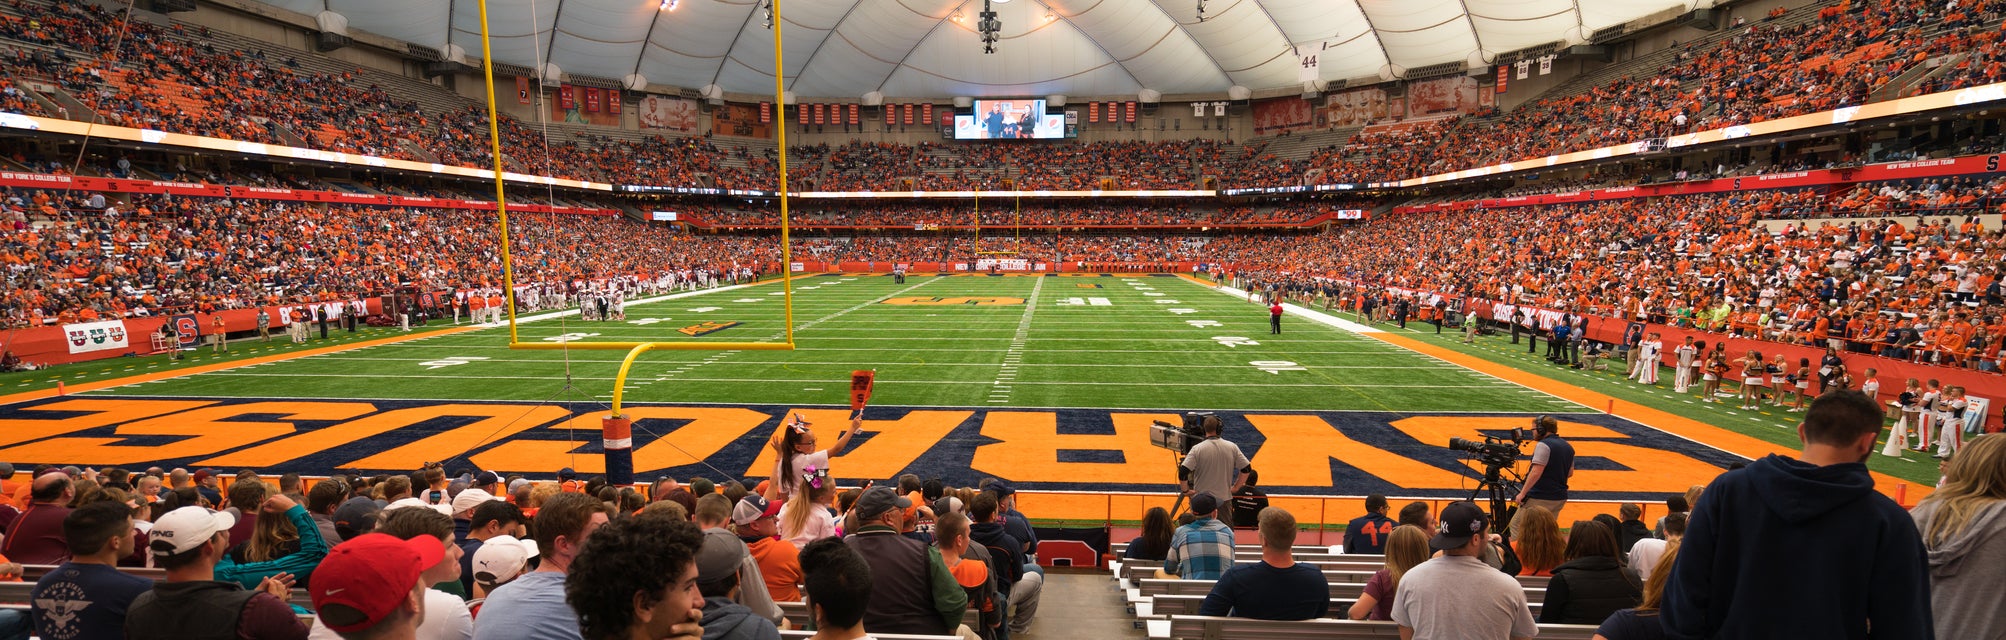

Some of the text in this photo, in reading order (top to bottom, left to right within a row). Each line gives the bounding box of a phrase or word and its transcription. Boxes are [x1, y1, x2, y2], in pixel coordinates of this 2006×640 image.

[1302, 55, 1317, 68] 44
[1986, 156, 2000, 171] S
[1734, 178, 1740, 189] S
[224, 185, 232, 197] S
[387, 196, 392, 205] S
[955, 263, 968, 271] NEW
[1027, 263, 1046, 271] TAM
[176, 317, 198, 344] S
[152, 530, 174, 538] PING
[40, 582, 85, 600] UNITED STATES
[53, 628, 80, 640] AMERICA
